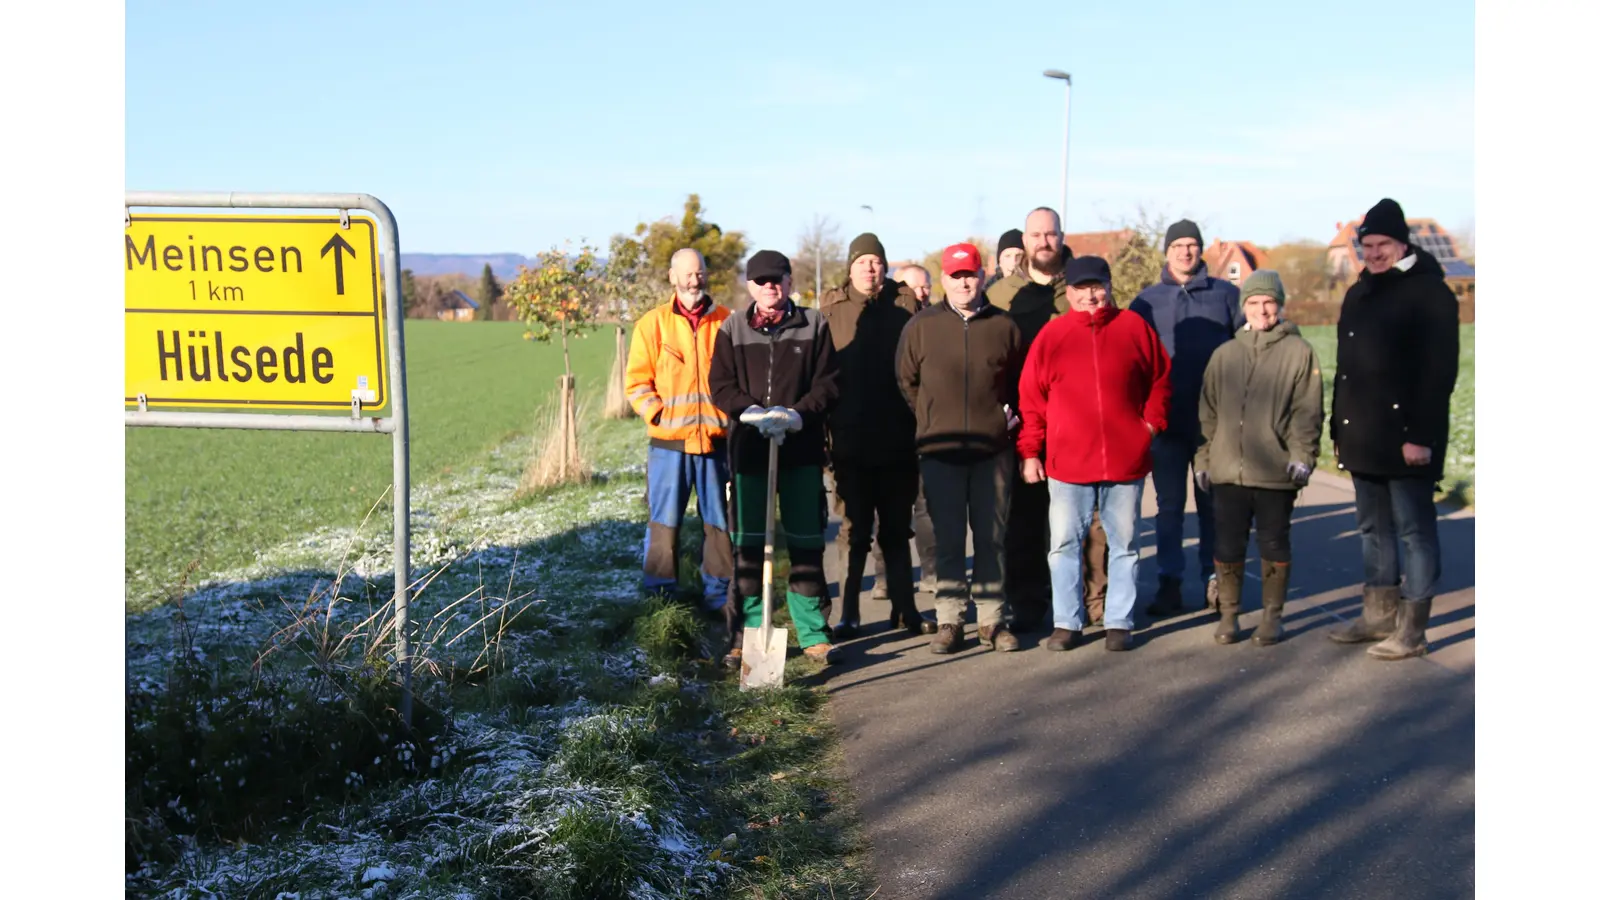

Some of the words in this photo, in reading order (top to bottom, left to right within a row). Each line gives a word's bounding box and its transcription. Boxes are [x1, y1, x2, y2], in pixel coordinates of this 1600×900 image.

[125, 234, 303, 273] Meinsen
[188, 280, 197, 301] 1
[208, 280, 245, 302] km
[156, 329, 335, 385] Hülsede
